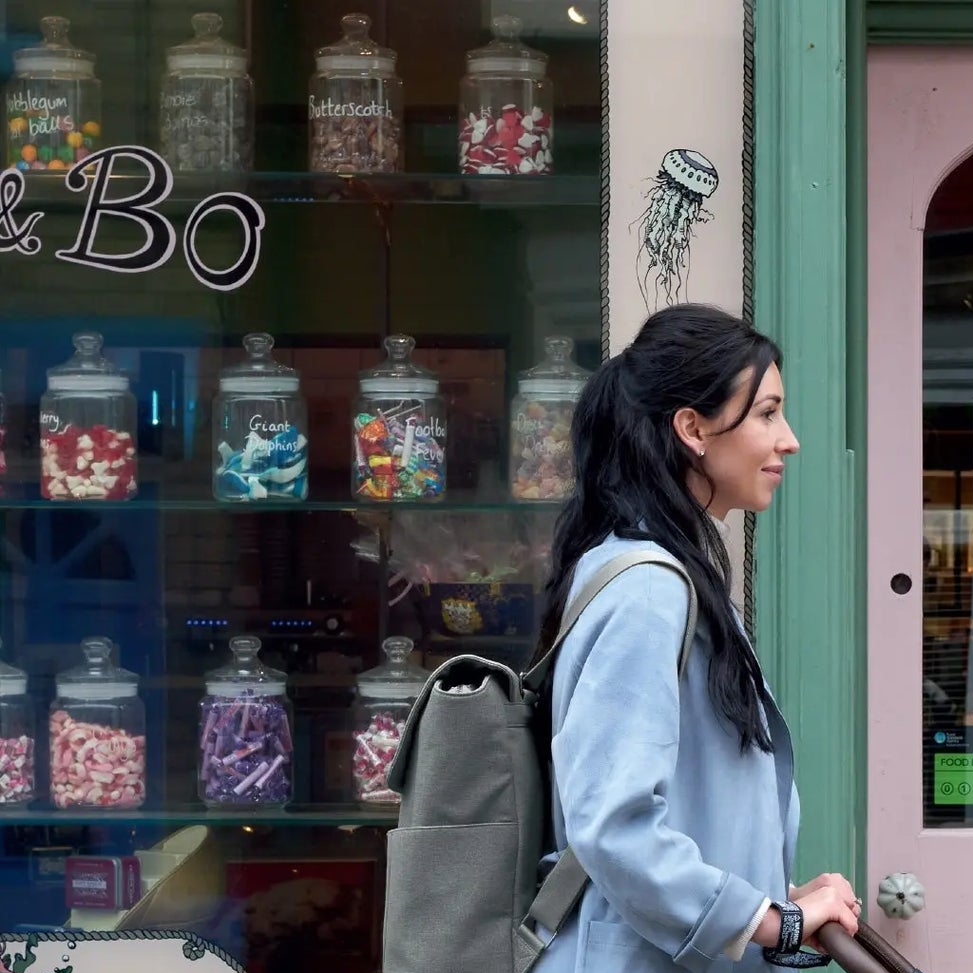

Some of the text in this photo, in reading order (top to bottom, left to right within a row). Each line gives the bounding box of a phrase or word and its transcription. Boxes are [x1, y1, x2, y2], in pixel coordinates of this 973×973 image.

[6, 88, 68, 120] ubblegum
[308, 94, 394, 120] Butterscotch
[28, 115, 75, 137] balls
[55, 145, 266, 292] Bo
[249, 414, 291, 433] Giant
[940, 758, 969, 767] FOOD
